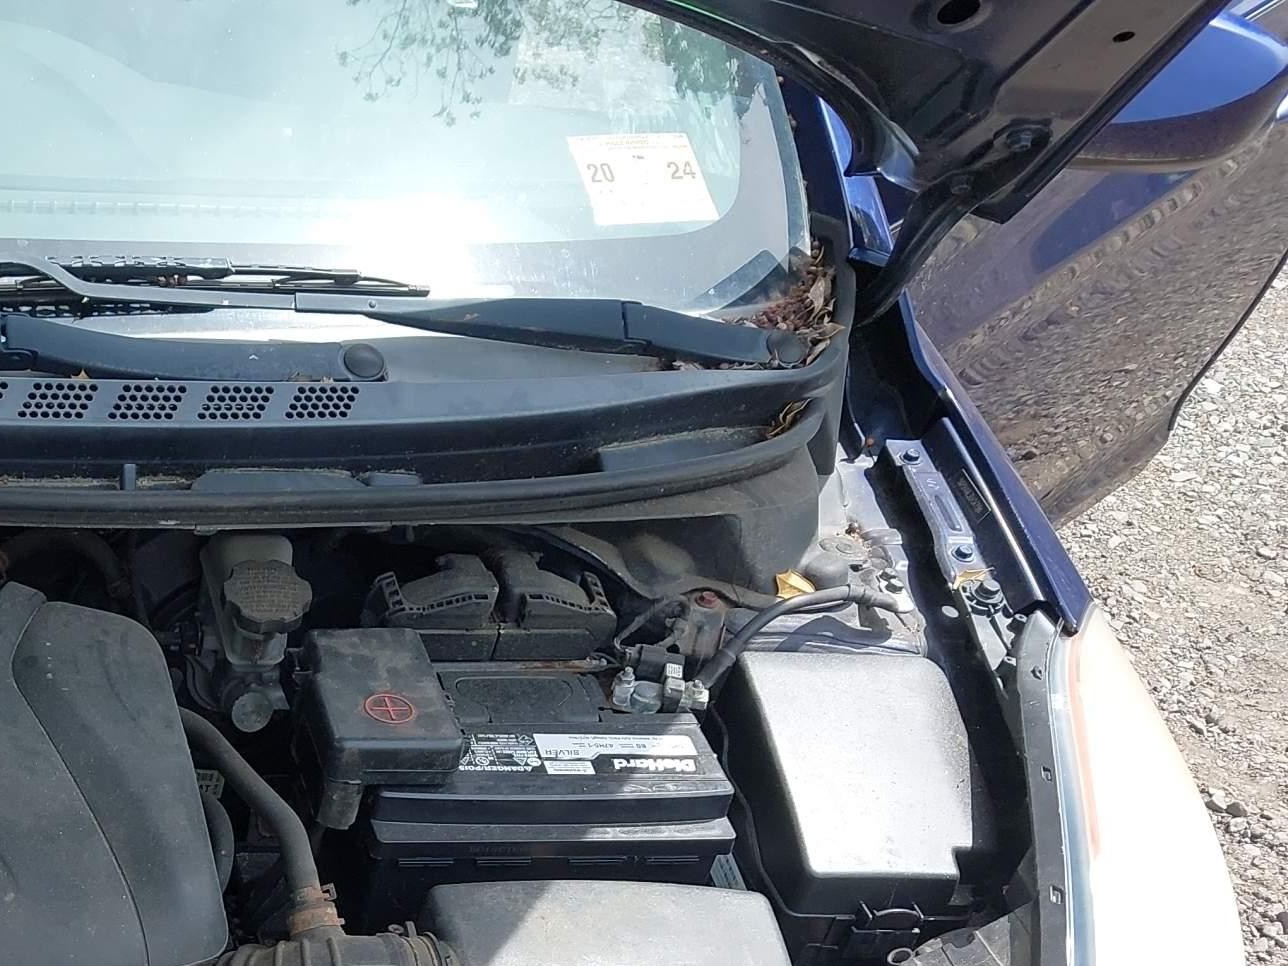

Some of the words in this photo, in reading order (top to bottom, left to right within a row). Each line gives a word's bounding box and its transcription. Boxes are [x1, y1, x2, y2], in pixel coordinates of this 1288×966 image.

[586, 162, 615, 183] 20
[666, 160, 697, 180] 24
[612, 758, 697, 772] DieHard
